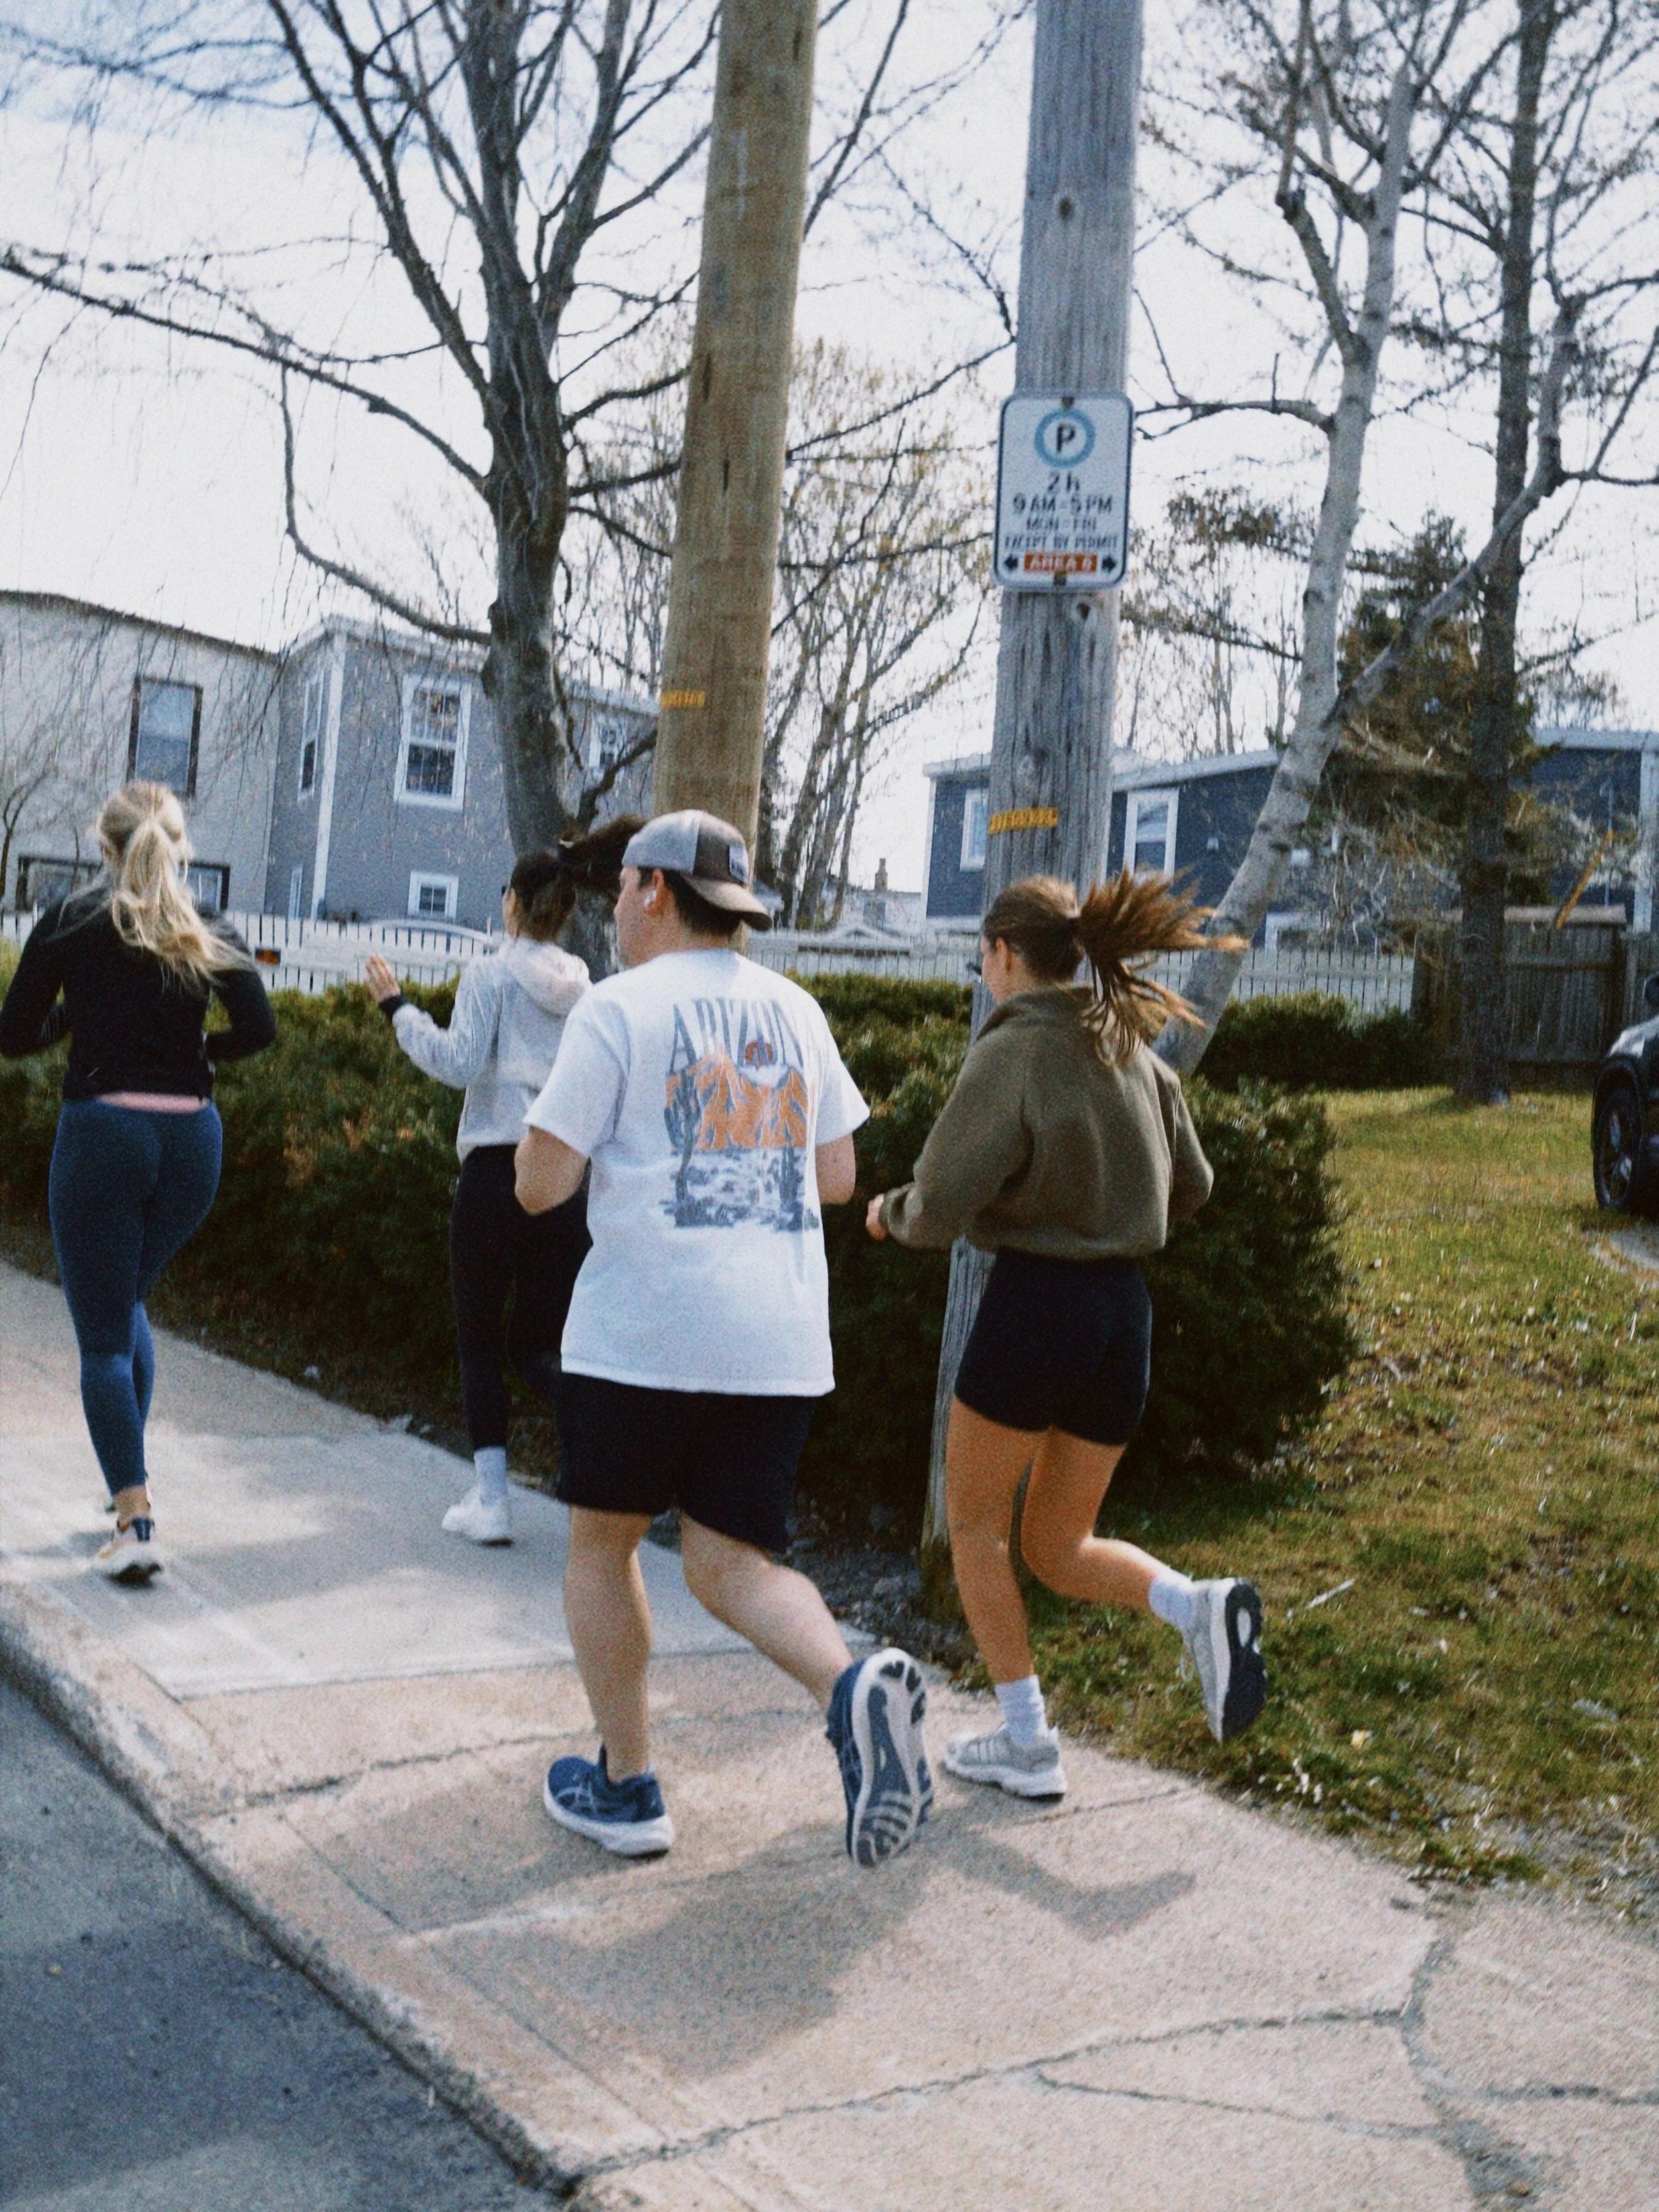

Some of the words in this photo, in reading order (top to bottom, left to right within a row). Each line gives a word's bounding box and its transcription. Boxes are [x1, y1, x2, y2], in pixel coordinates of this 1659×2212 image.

[1056, 423, 1076, 453] P
[1048, 471, 1060, 492] 2
[1066, 471, 1080, 492] h
[1013, 493, 1026, 514] 9
[1030, 494, 1056, 512] AM
[1070, 495, 1082, 514] 5
[1086, 494, 1112, 513] PM
[1027, 516, 1059, 532] MON
[1073, 516, 1097, 532] FRI
[1005, 535, 1046, 550] EXCEPT
[1074, 535, 1118, 550] PERMIT
[1029, 554, 1076, 571] AREA
